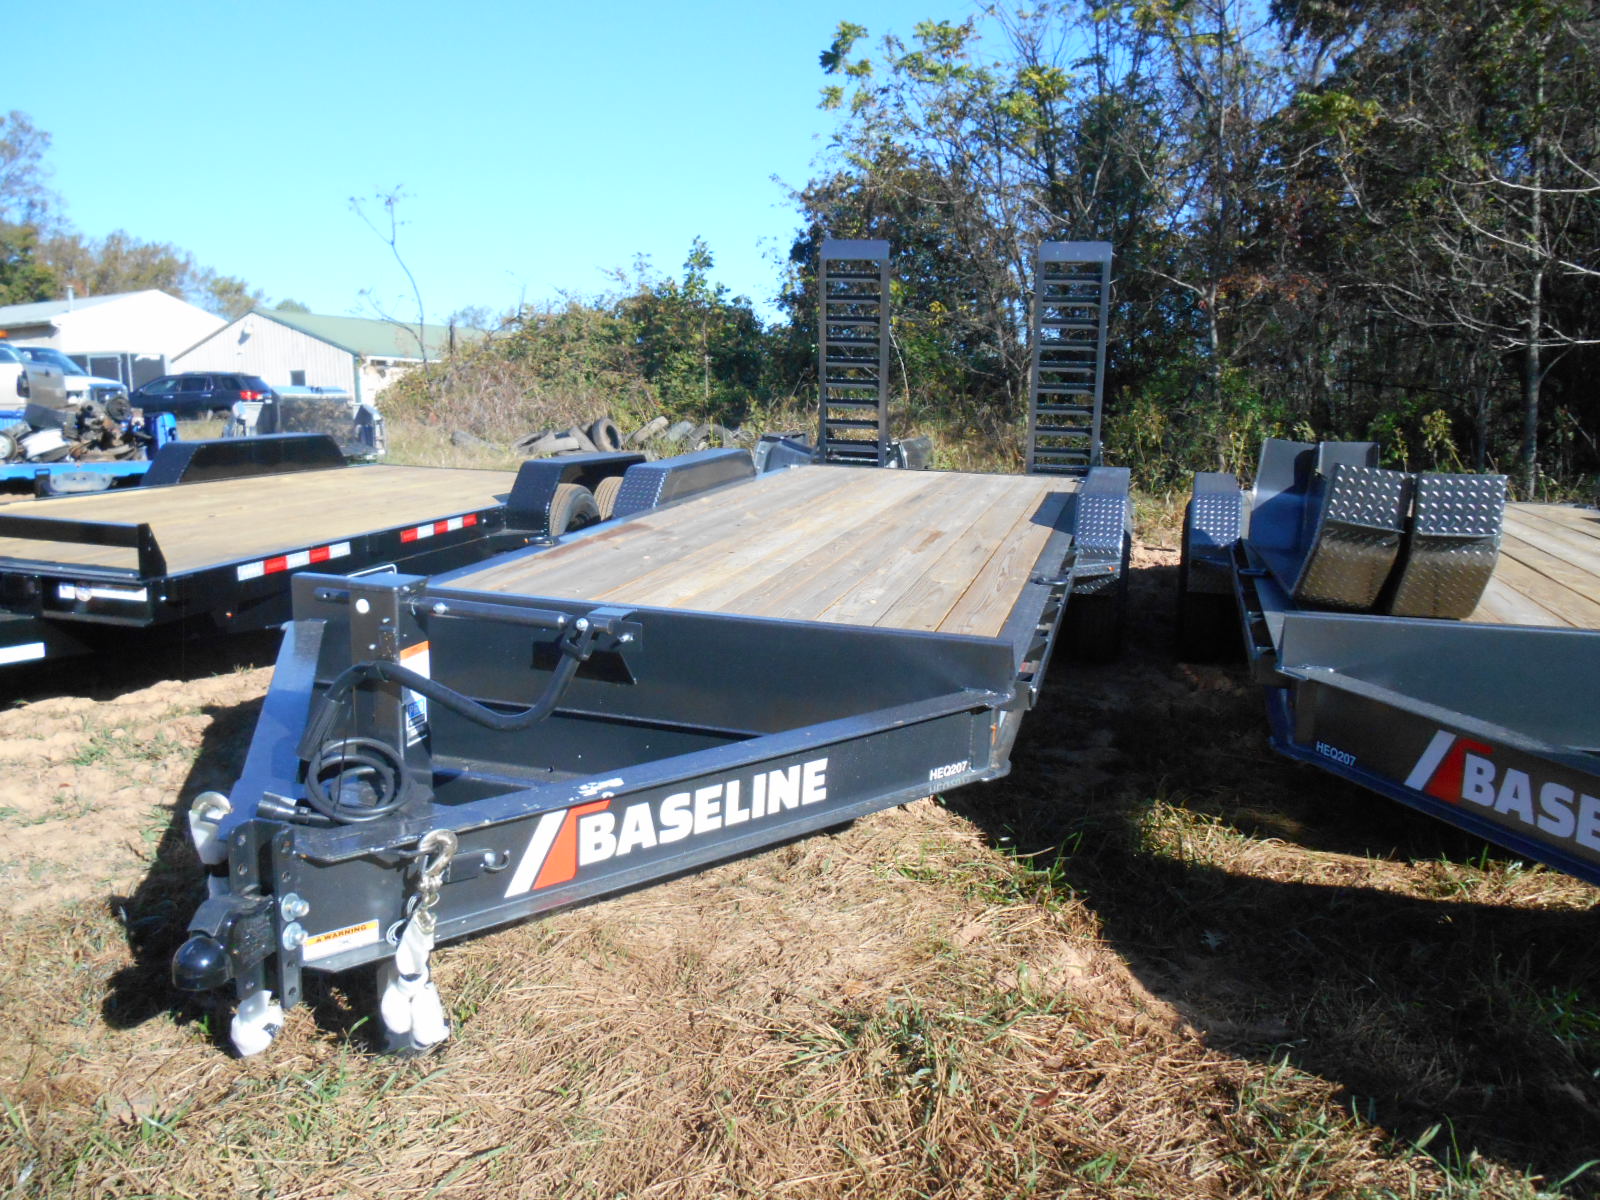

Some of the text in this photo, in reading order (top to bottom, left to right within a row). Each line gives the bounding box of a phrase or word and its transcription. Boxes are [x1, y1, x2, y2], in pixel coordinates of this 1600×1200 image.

[1316, 741, 1356, 766] HEQ207
[929, 760, 968, 780] HEQ207
[580, 758, 828, 866] BASELINE
[325, 924, 367, 940] WARNING
